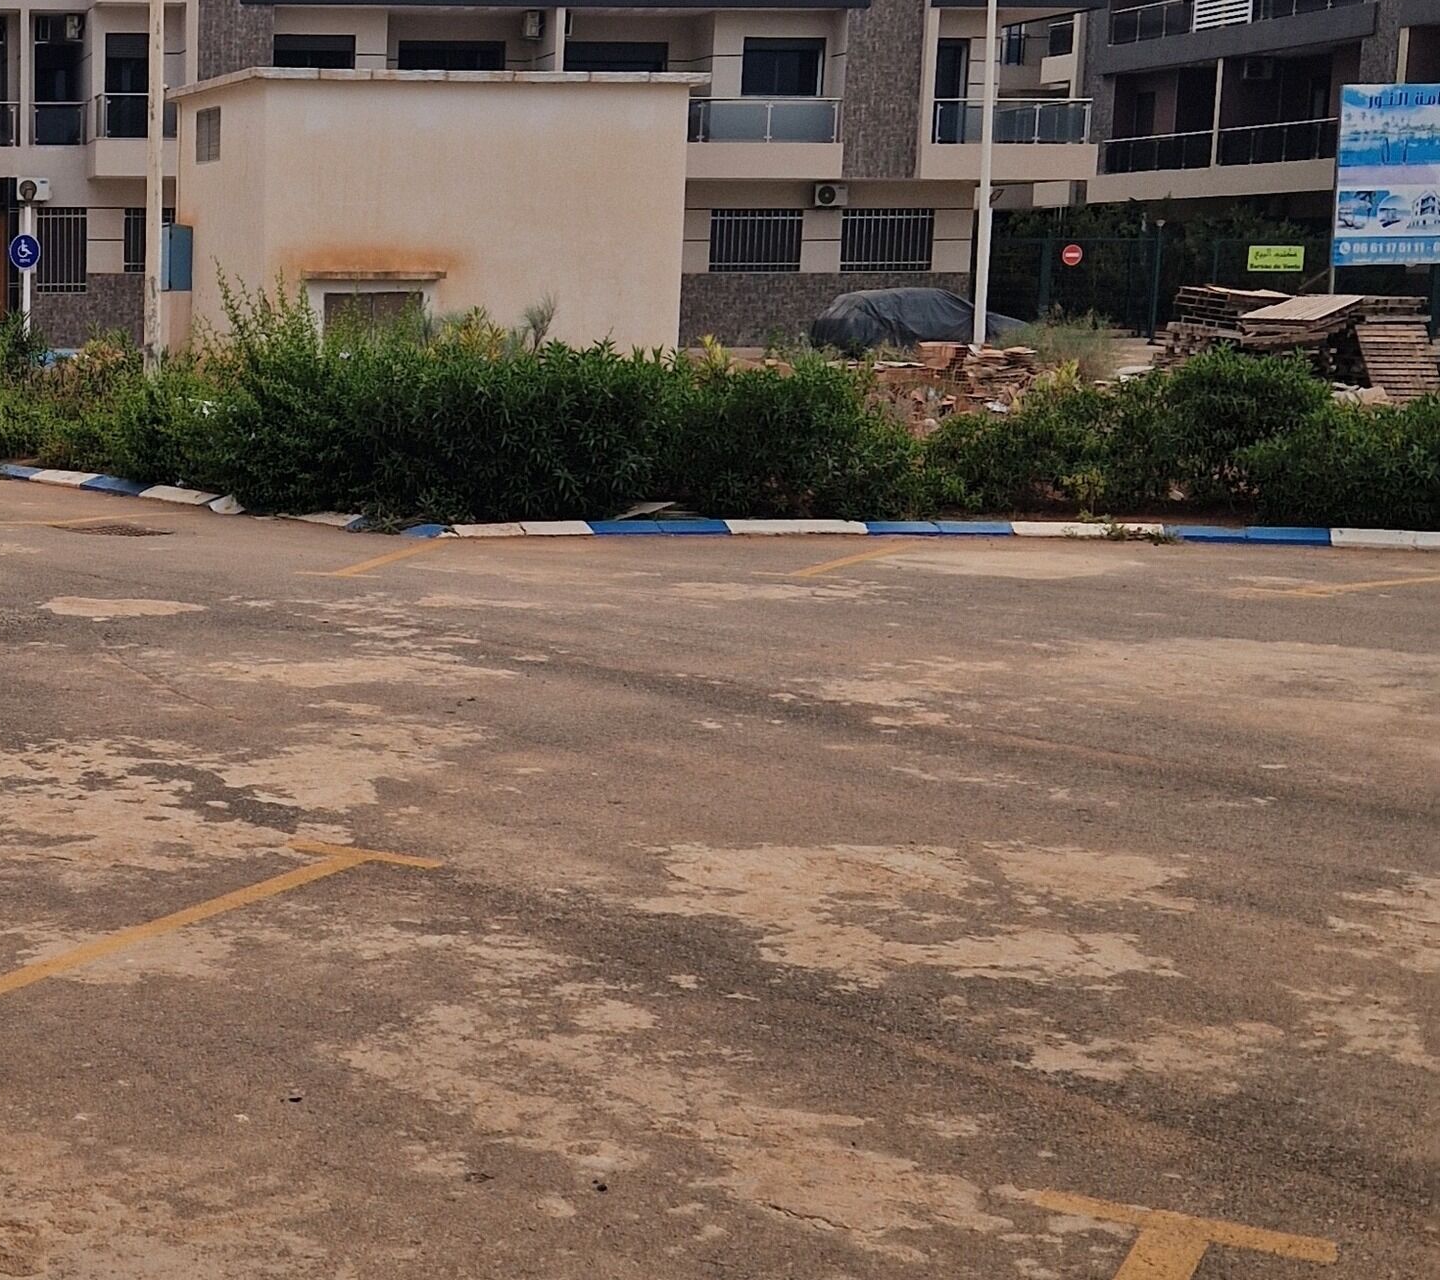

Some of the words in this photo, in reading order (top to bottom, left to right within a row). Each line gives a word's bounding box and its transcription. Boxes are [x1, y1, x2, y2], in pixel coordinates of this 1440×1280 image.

[1368, 92, 1409, 109] النور
[1352, 242, 1368, 254] 06
[1370, 242, 1384, 254] 61
[1386, 242, 1397, 254] 17
[1414, 242, 1425, 253] 11
